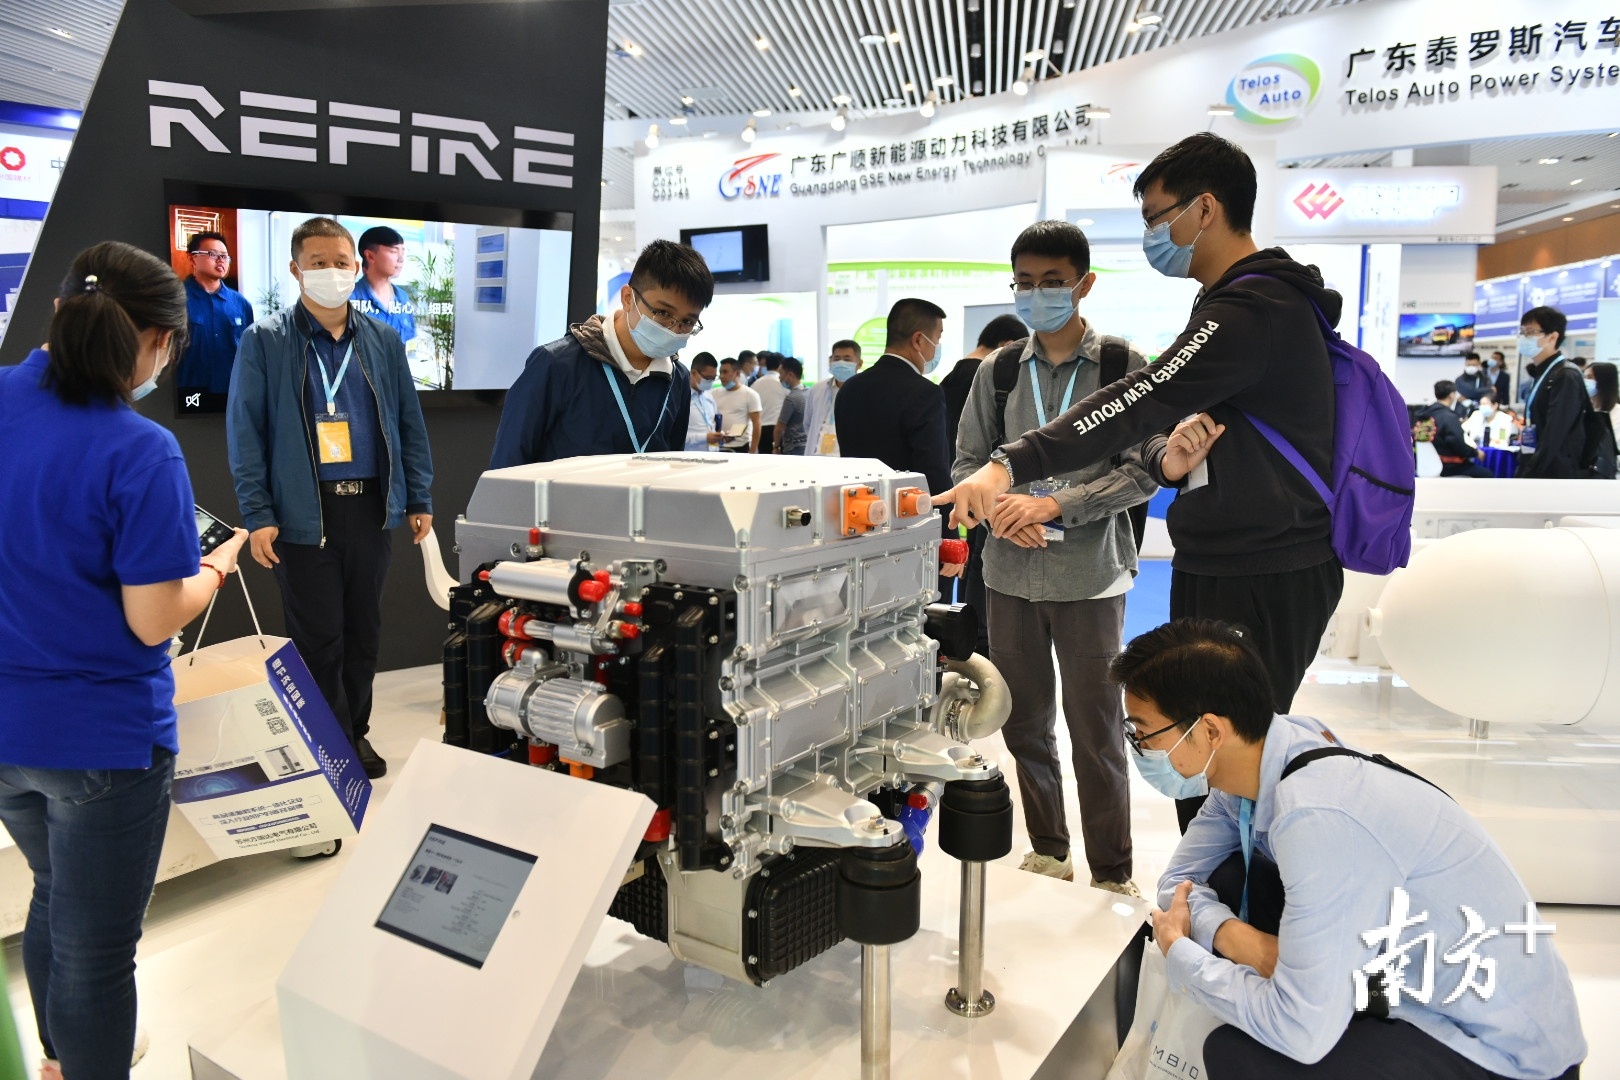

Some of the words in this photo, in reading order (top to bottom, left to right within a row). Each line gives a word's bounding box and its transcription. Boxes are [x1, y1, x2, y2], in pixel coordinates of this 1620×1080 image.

[1240, 73, 1280, 91] Telos
[1259, 89, 1302, 106] Auto
[1345, 87, 1399, 106] Telos
[1407, 80, 1460, 99] Auto
[1469, 71, 1540, 92] Power
[148, 79, 575, 189] REFIRE
[790, 103, 1092, 176] 广东广顺新能源动力科技有限公司
[790, 178, 857, 197] Guangdong
[859, 172, 886, 188] GSE
[888, 171, 913, 184] New
[916, 164, 958, 182] Energy
[963, 149, 1032, 174] Technology
[1122, 379, 1154, 407] NEW
[1073, 397, 1126, 435] ROUTE
[1152, 1044, 1200, 1080] MBIO
